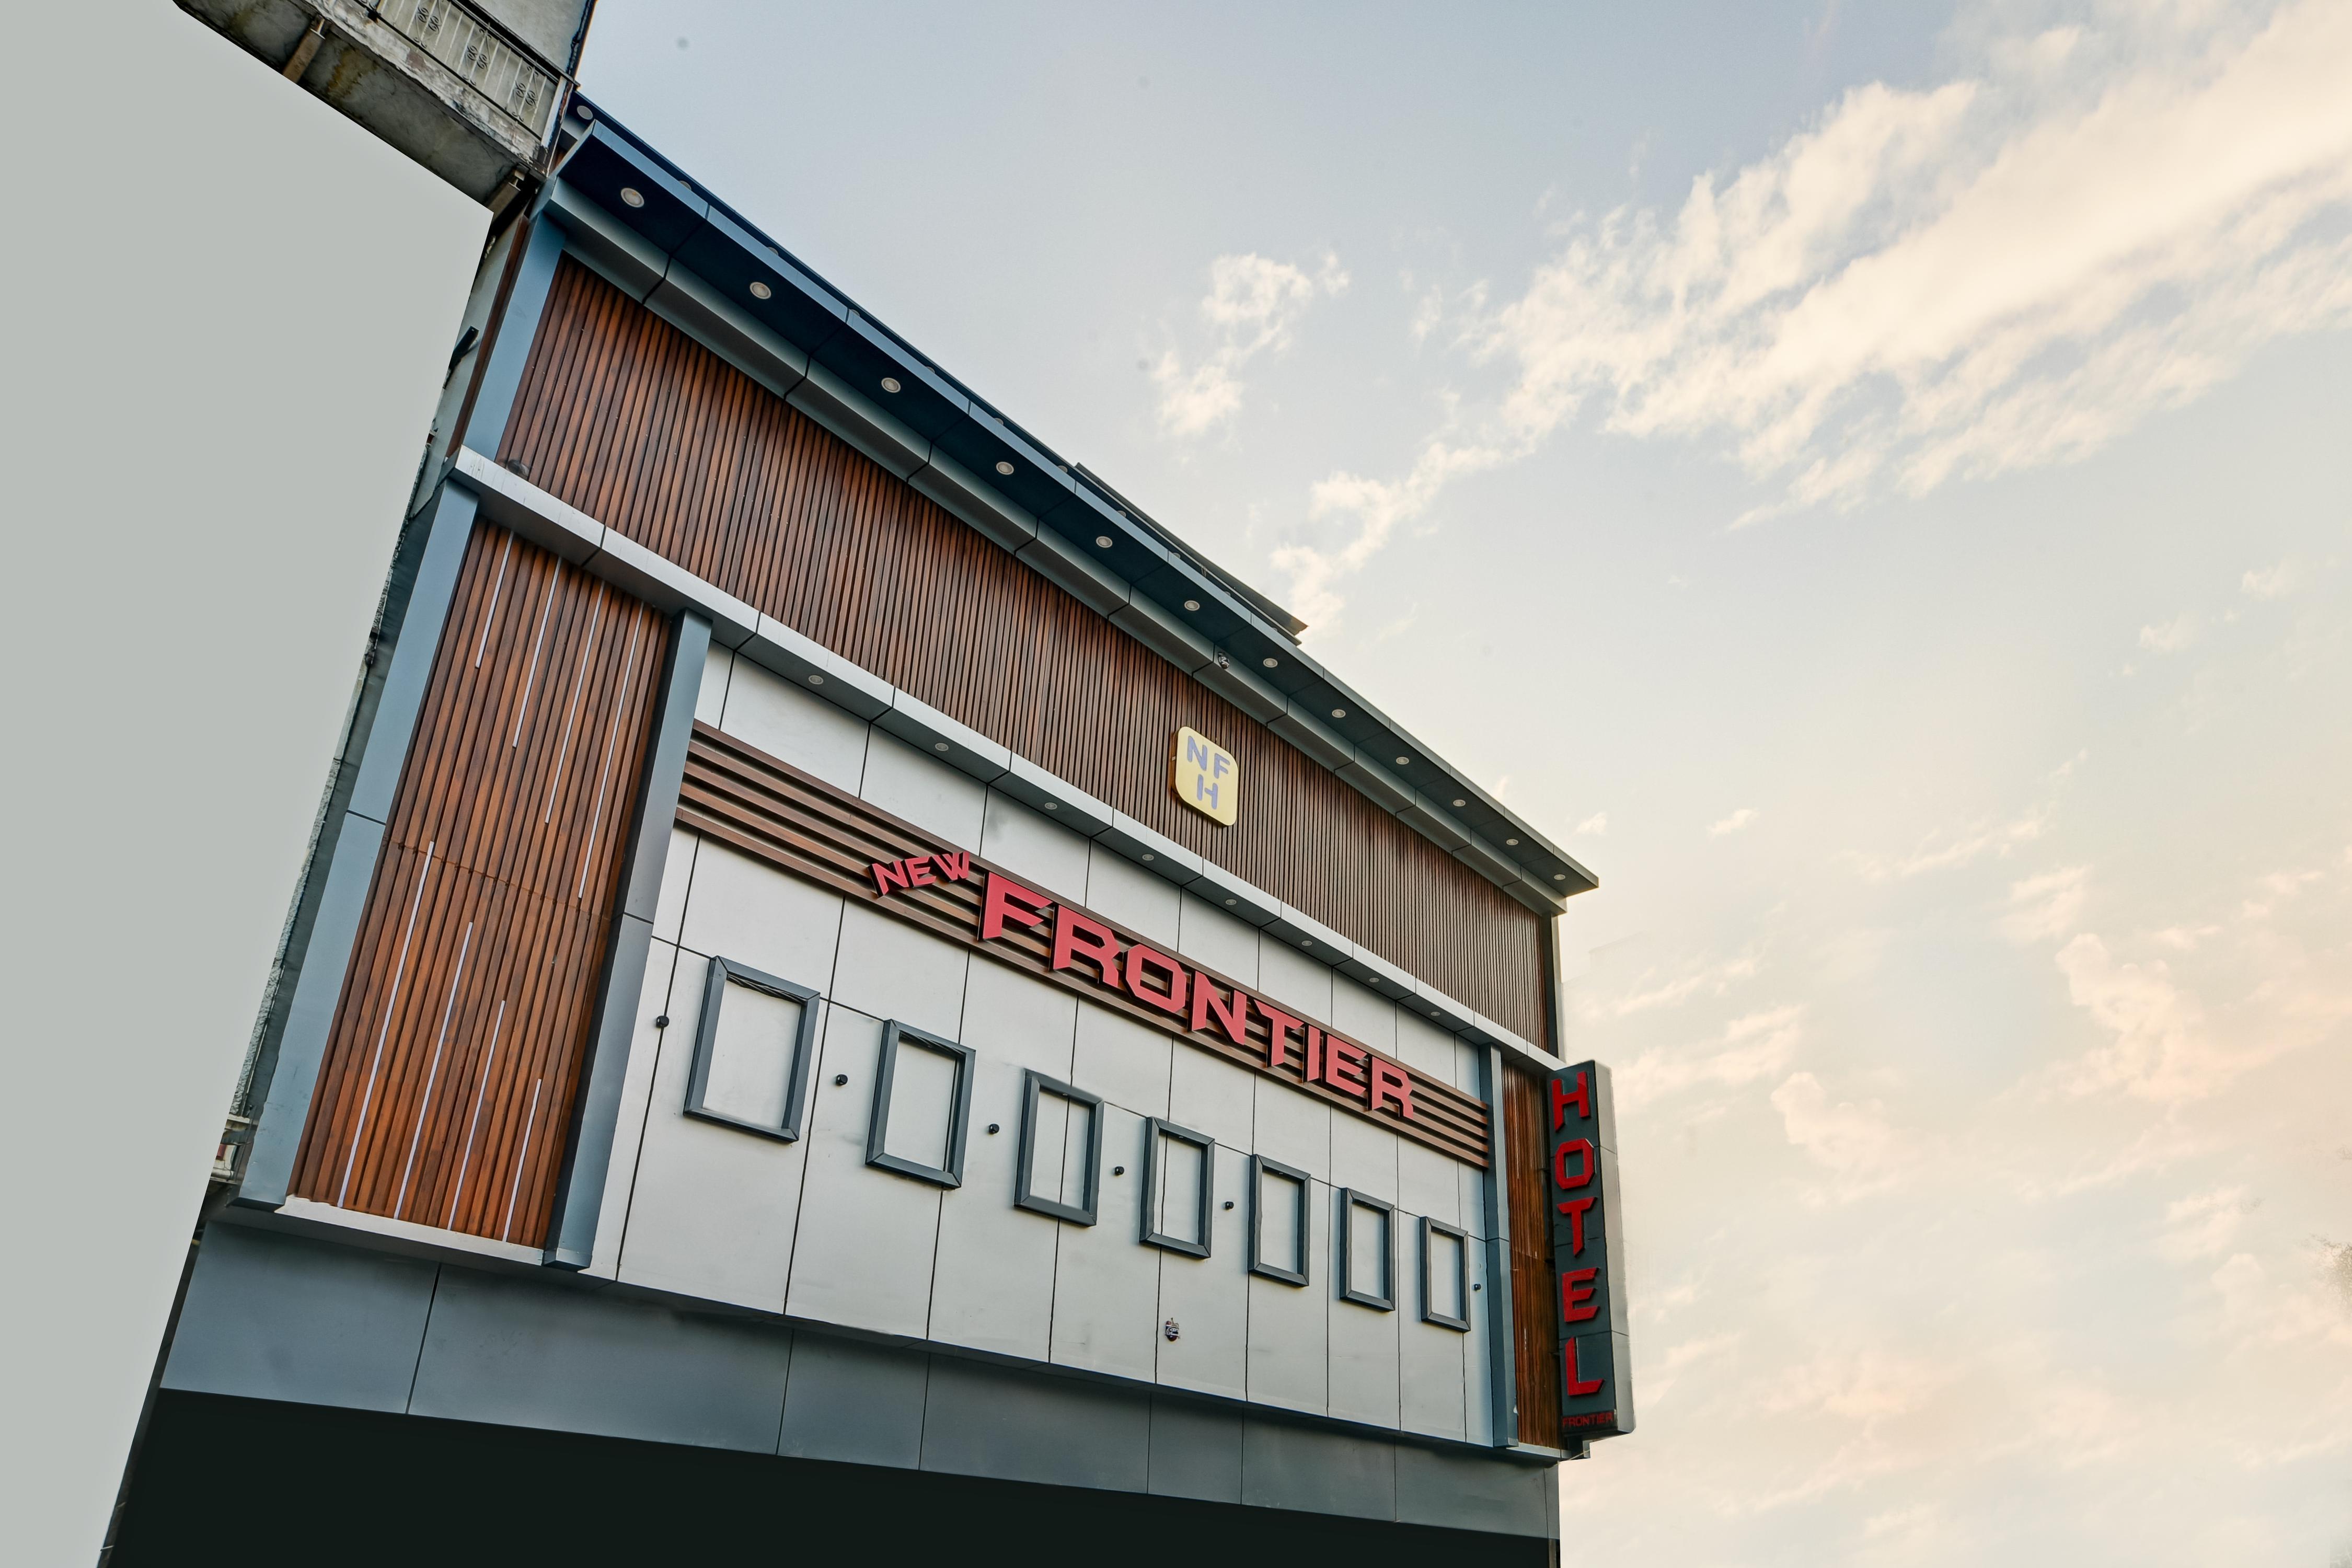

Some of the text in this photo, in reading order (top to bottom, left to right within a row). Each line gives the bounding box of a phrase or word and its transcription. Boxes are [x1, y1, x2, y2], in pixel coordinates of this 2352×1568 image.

[1187, 735, 1230, 779] NF
[1196, 774, 1218, 810] H
[869, 850, 1413, 1118] NEW FRONTIER
[1551, 1071, 1604, 1396] HOTEL
[1562, 1411, 1613, 1427] FRONTIER
